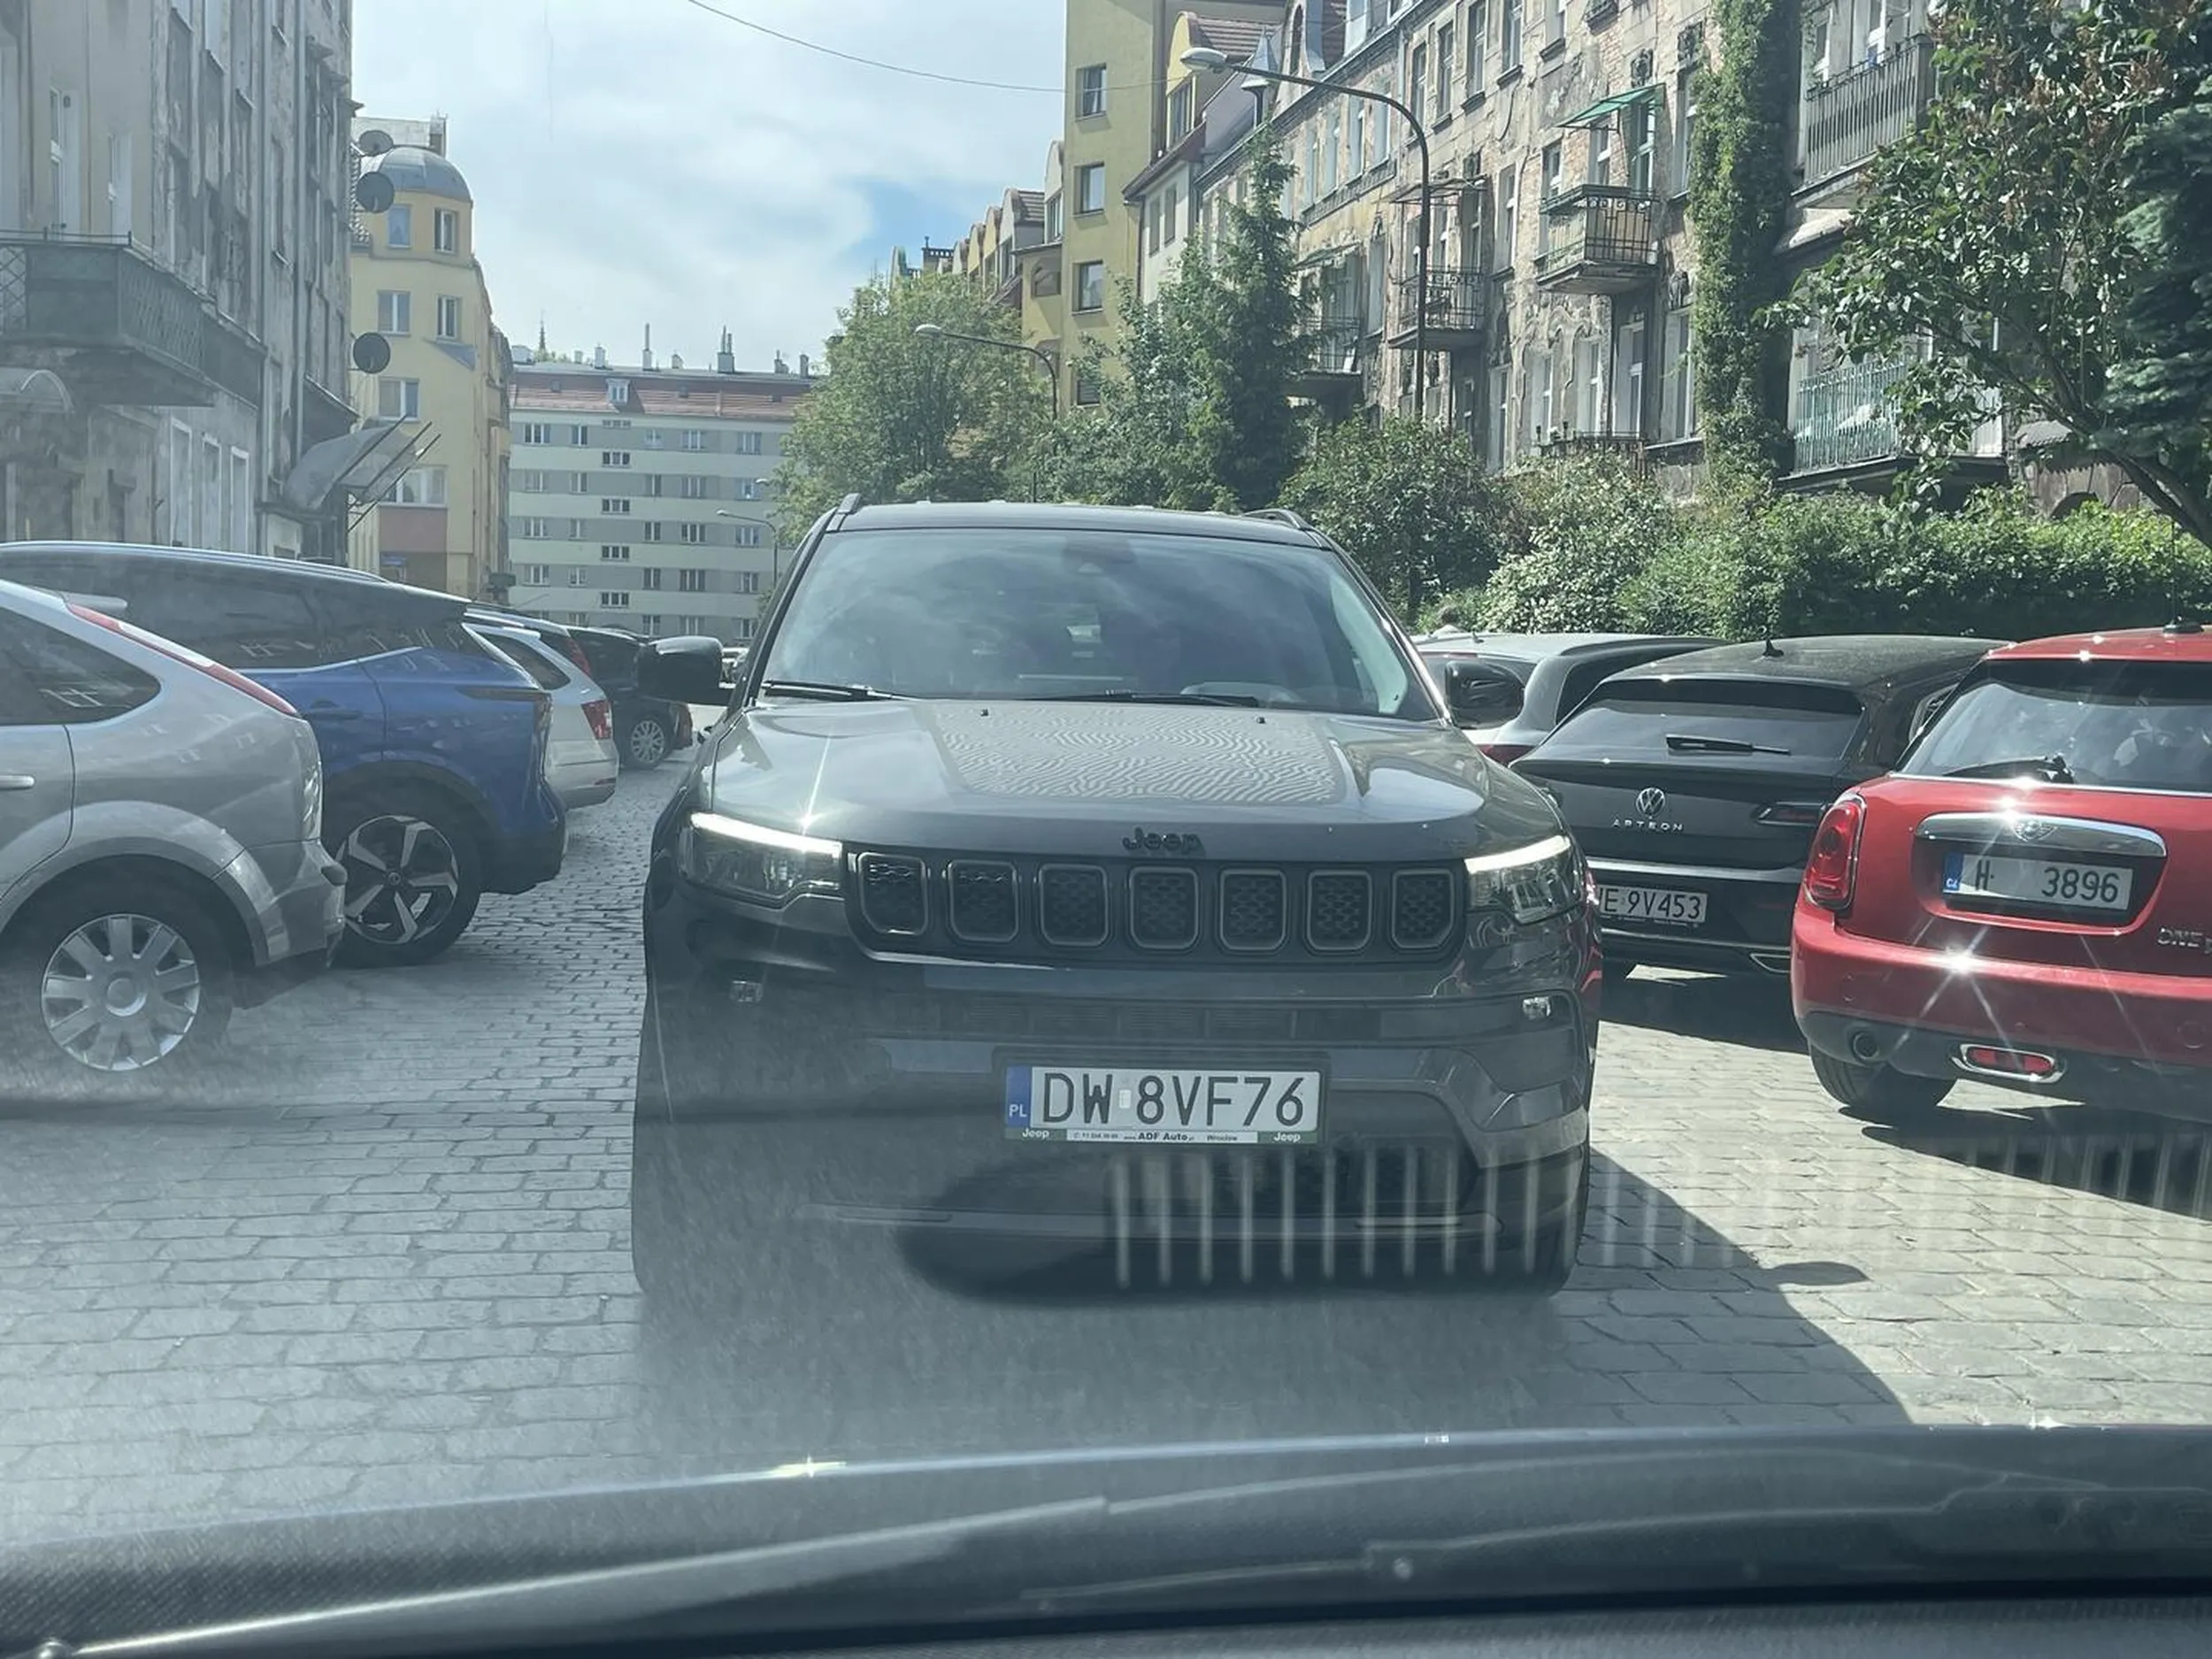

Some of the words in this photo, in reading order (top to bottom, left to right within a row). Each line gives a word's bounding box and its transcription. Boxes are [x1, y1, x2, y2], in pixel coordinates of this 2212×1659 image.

[1611, 818, 1683, 831] ARTEON
[1122, 827, 1202, 855] Jeep
[2041, 867, 2120, 902] 3896
[1598, 887, 1618, 912] E
[1628, 891, 1701, 919] 9V453
[1043, 1072, 1113, 1125] DW
[1136, 1075, 1304, 1127] 8VF76
[1009, 1103, 1027, 1118] PL
[1022, 1128, 1050, 1140] Jeep
[1273, 1133, 1302, 1144] Jeep
